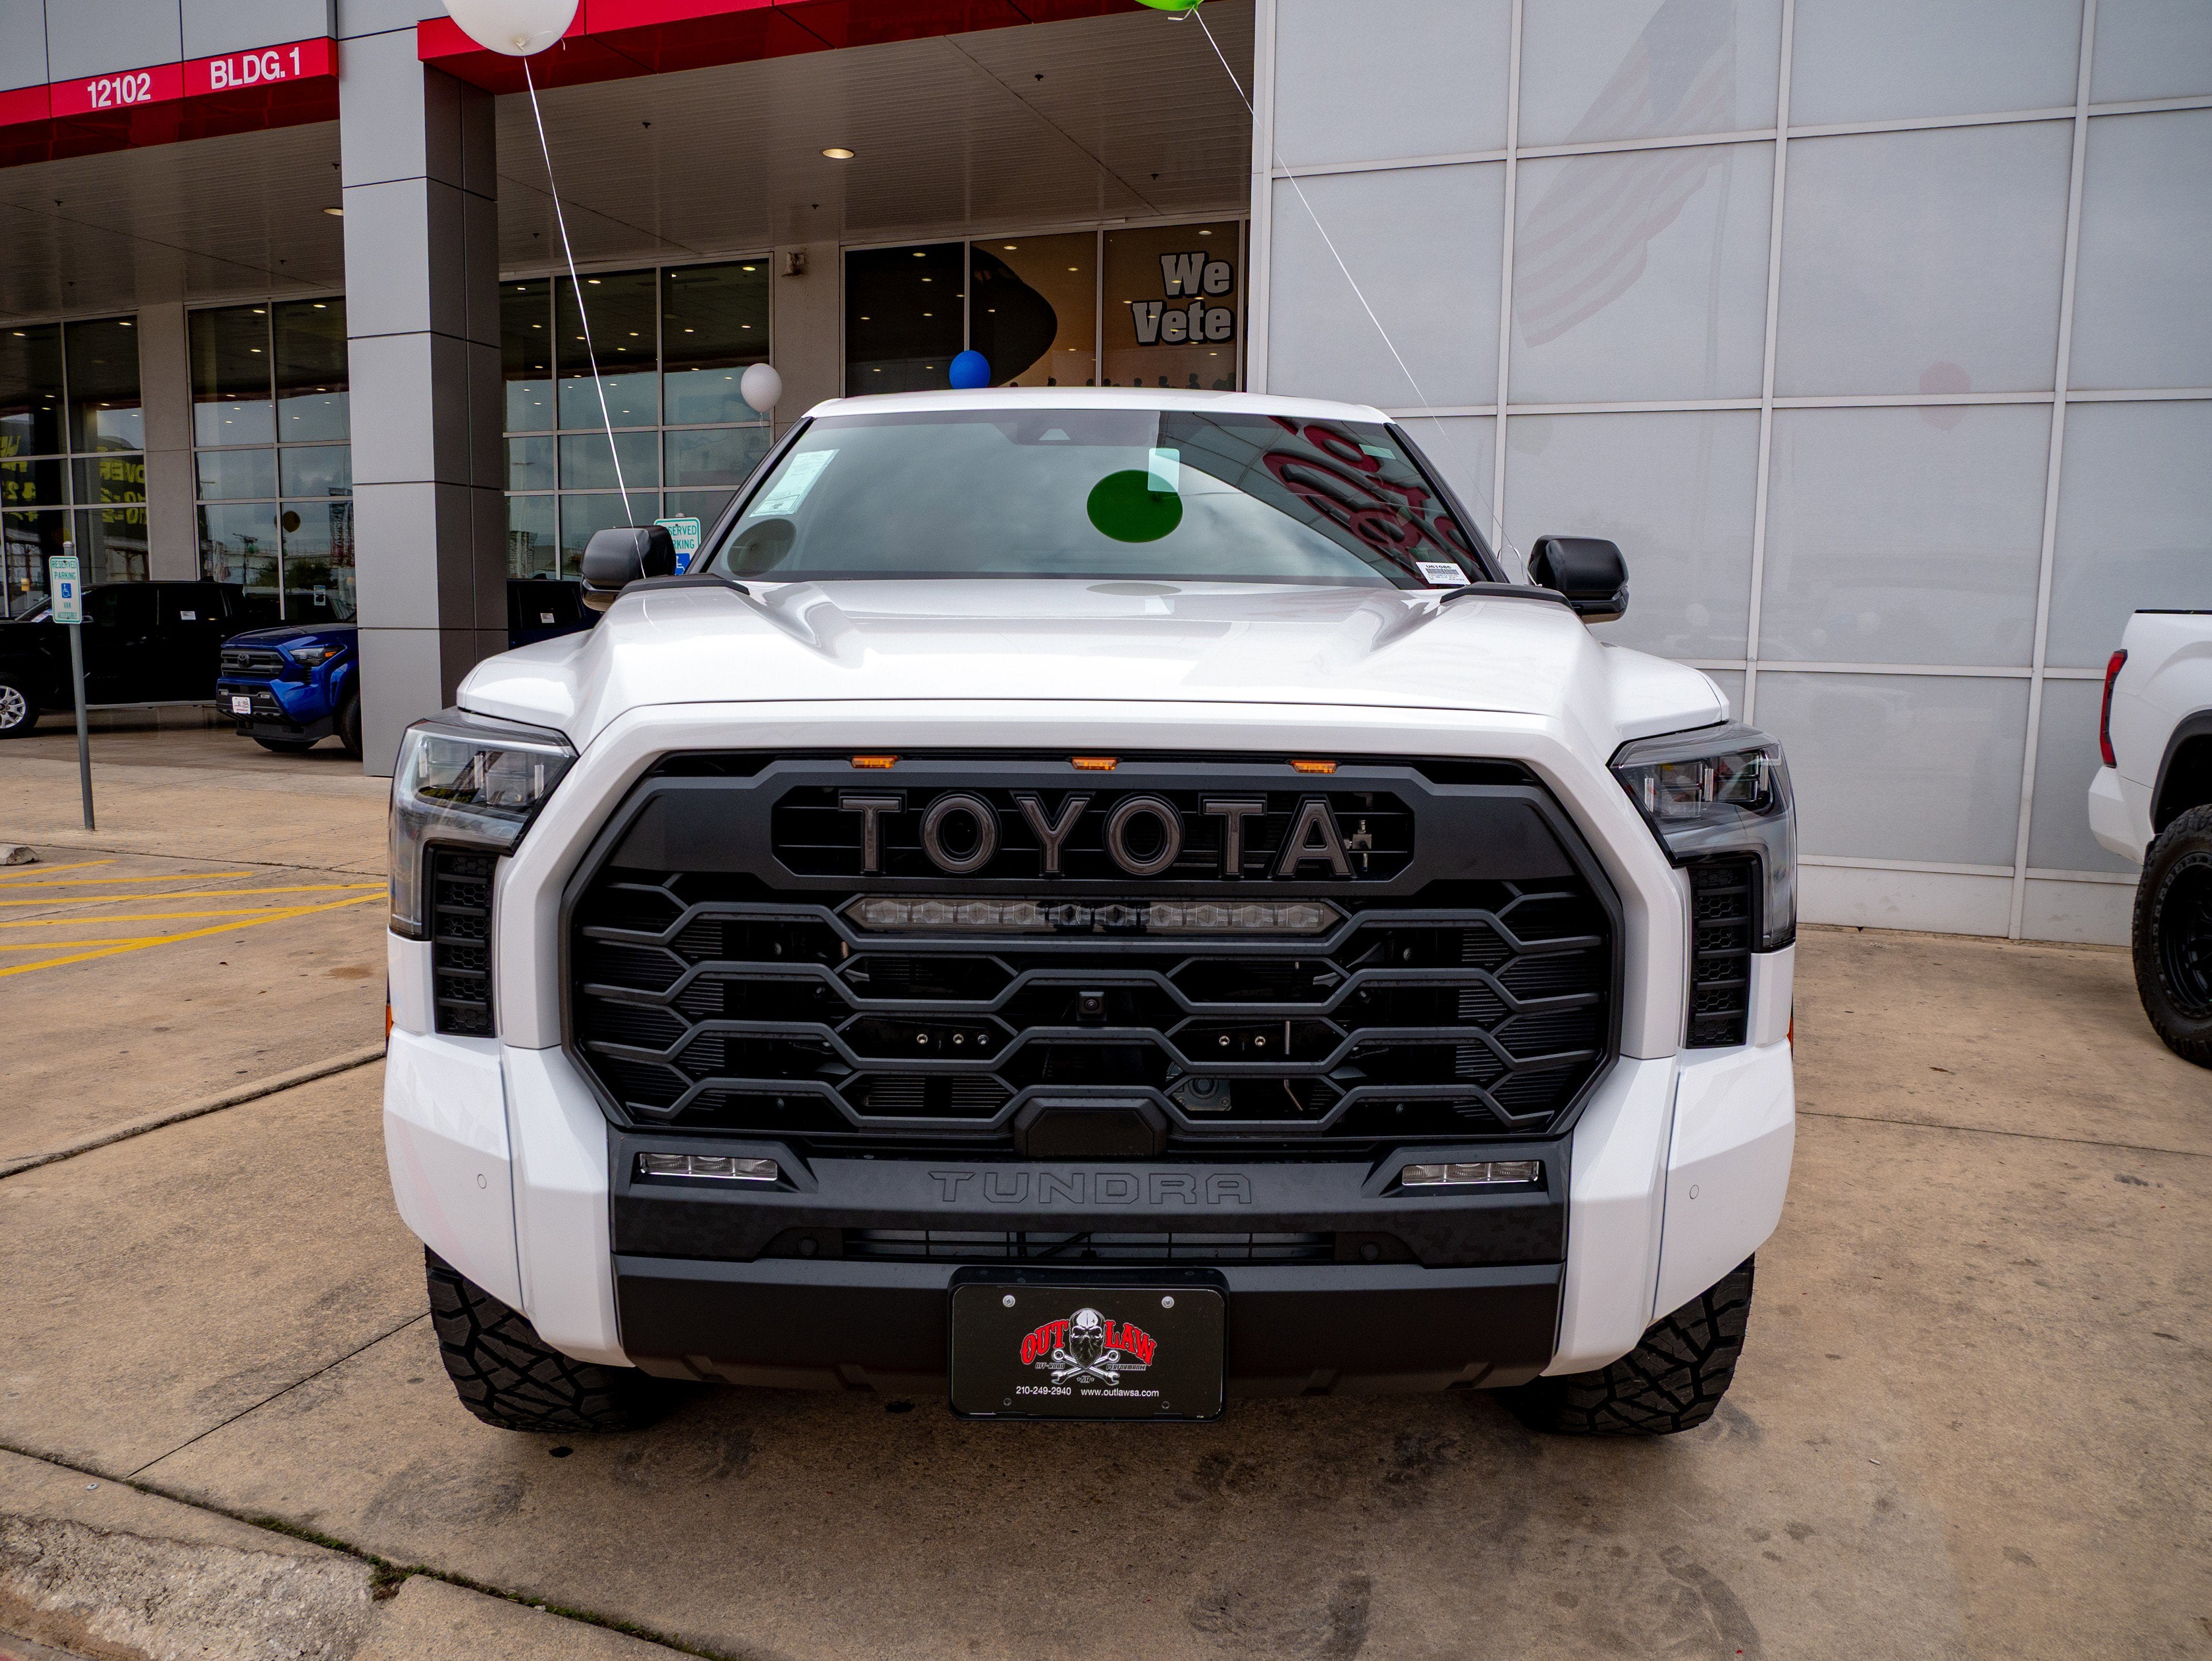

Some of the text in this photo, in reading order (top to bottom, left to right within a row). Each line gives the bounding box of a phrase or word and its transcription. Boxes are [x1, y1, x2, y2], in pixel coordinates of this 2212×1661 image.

[210, 47, 300, 90] BLDG. 1
[87, 73, 151, 108] 12102
[1160, 251, 1233, 298] We
[1131, 300, 1235, 345] Vete
[668, 525, 696, 535] SERVED
[673, 539, 695, 549] RKING
[51, 561, 77, 569] RESERVED
[54, 572, 75, 580] PARKING
[839, 791, 1354, 877] TOYOTA
[927, 1171, 1252, 1205] TUNDRA
[1016, 1386, 1159, 1397] 210-249-2940 www.outlawsa.com
